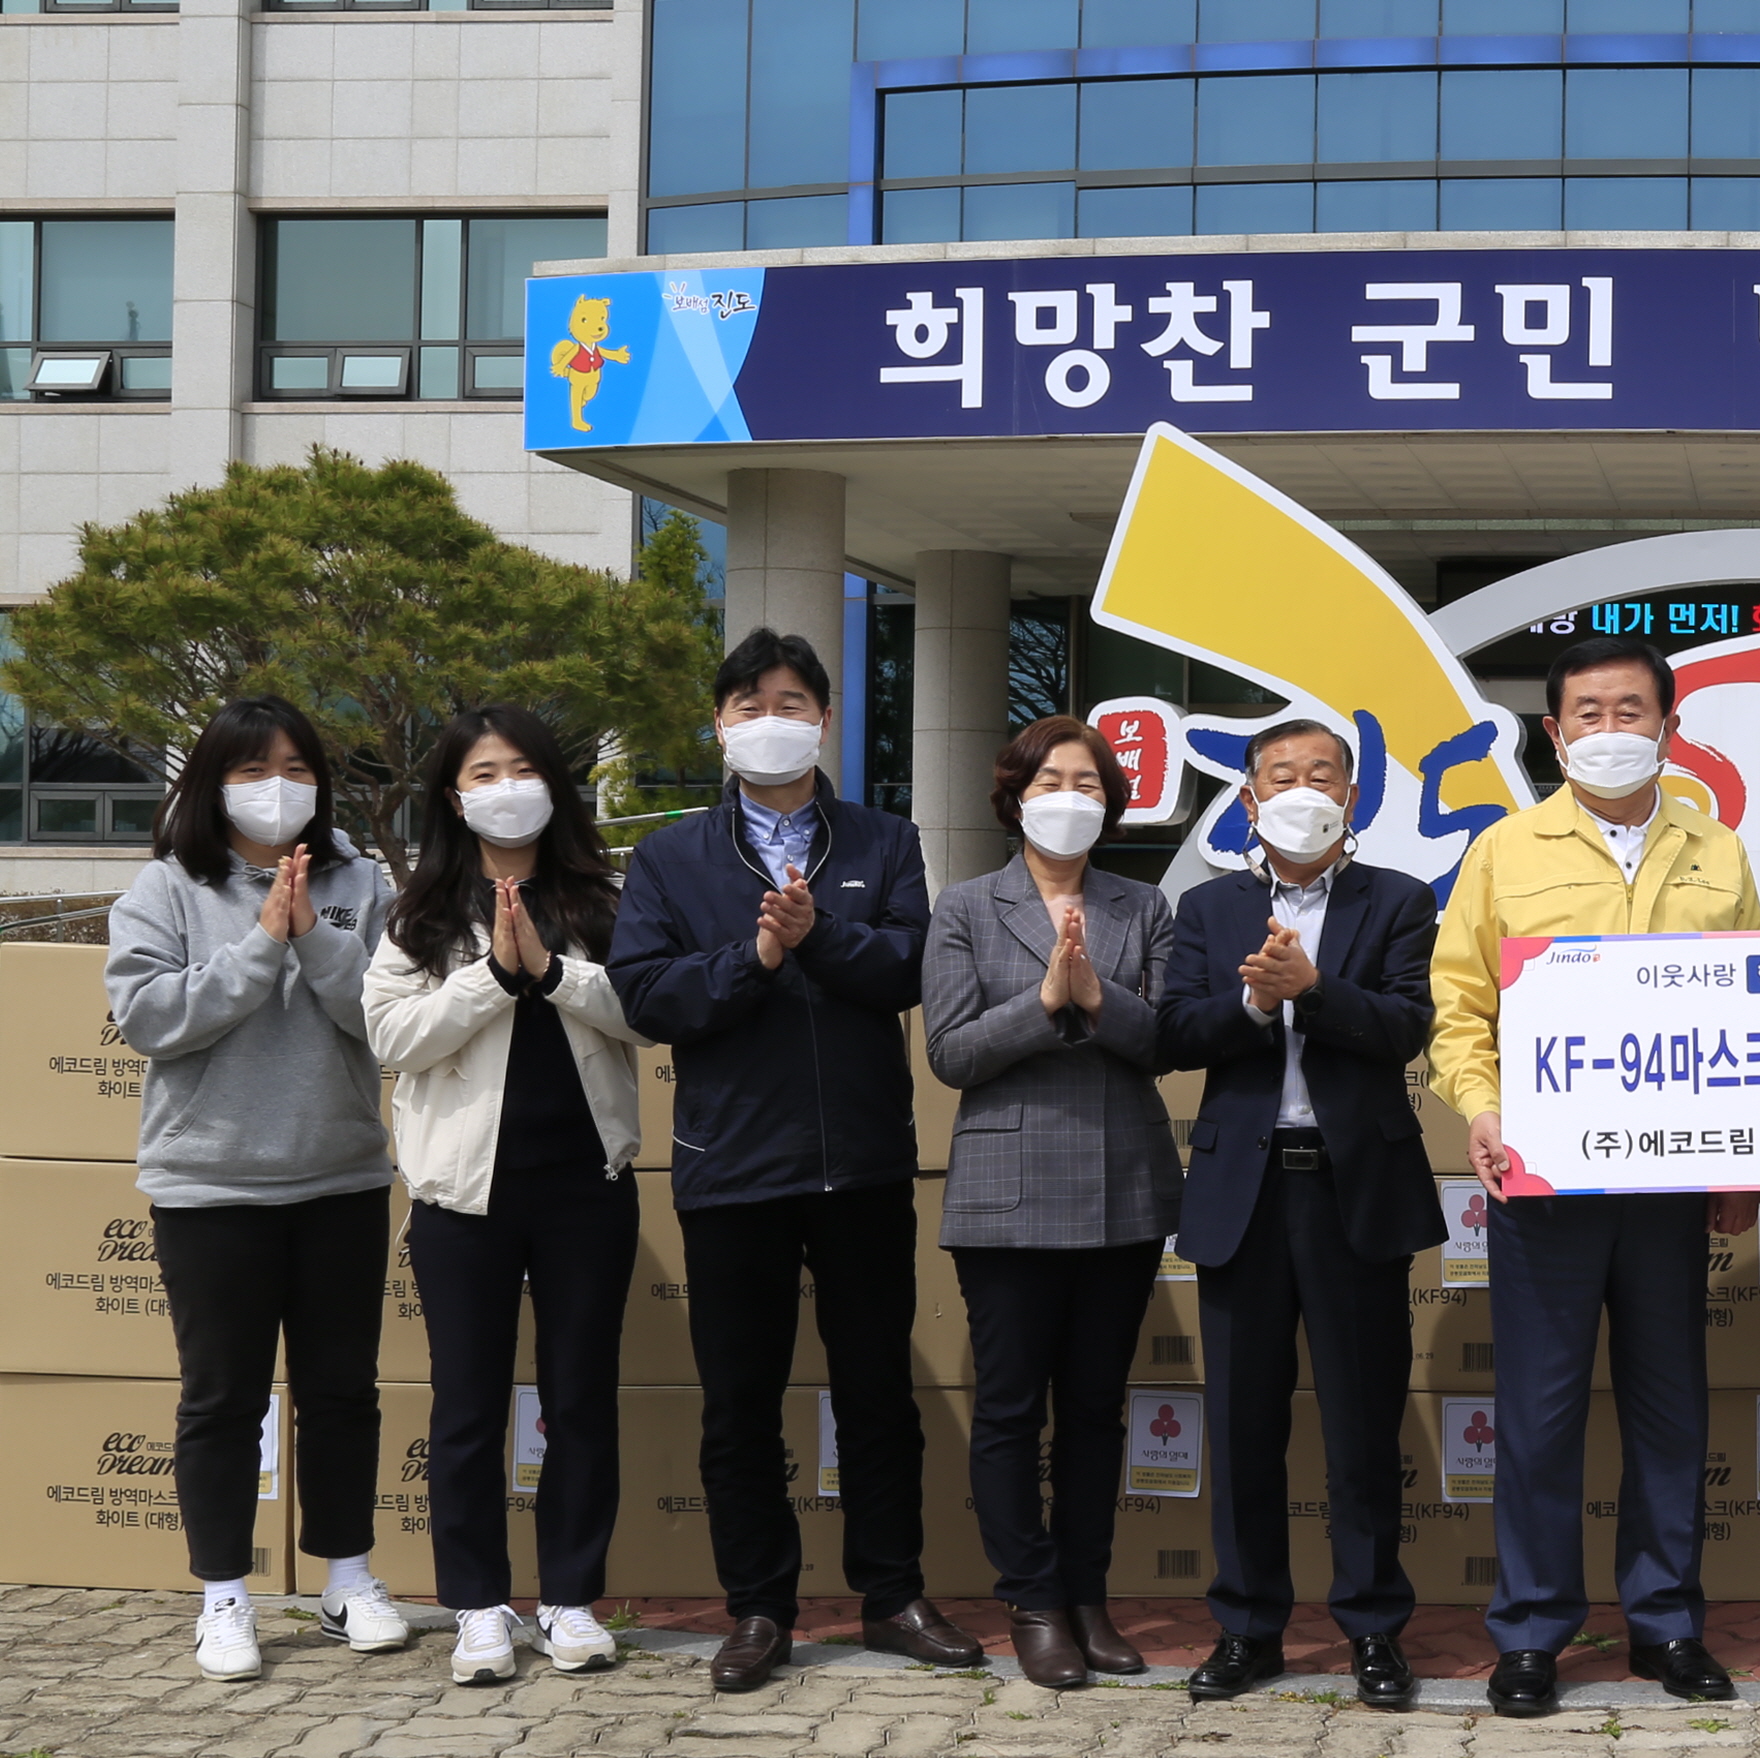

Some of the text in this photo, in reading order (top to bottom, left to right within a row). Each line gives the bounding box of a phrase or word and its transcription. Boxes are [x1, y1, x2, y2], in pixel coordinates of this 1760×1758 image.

[711, 290, 757, 319] 진도
[880, 279, 1271, 408] 희망찬
[1352, 277, 1613, 400] 군민
[1592, 603, 1654, 634] 내가
[1668, 603, 1739, 634] 먼저!
[1546, 951, 1592, 965] Jindo
[1636, 962, 1737, 989] 이웃사랑
[49, 1056, 107, 1076] 에코드림
[97, 1080, 142, 1099] 화이트
[1580, 1126, 1756, 1161] (주)에코드림
[103, 1218, 148, 1239] eco
[97, 1239, 158, 1262] Drea
[46, 1272, 104, 1292] 에코드림
[95, 1297, 140, 1315] 화이트
[103, 1432, 146, 1453] eco
[47, 1485, 104, 1505] 에코드림
[96, 1509, 140, 1527] 화이트
